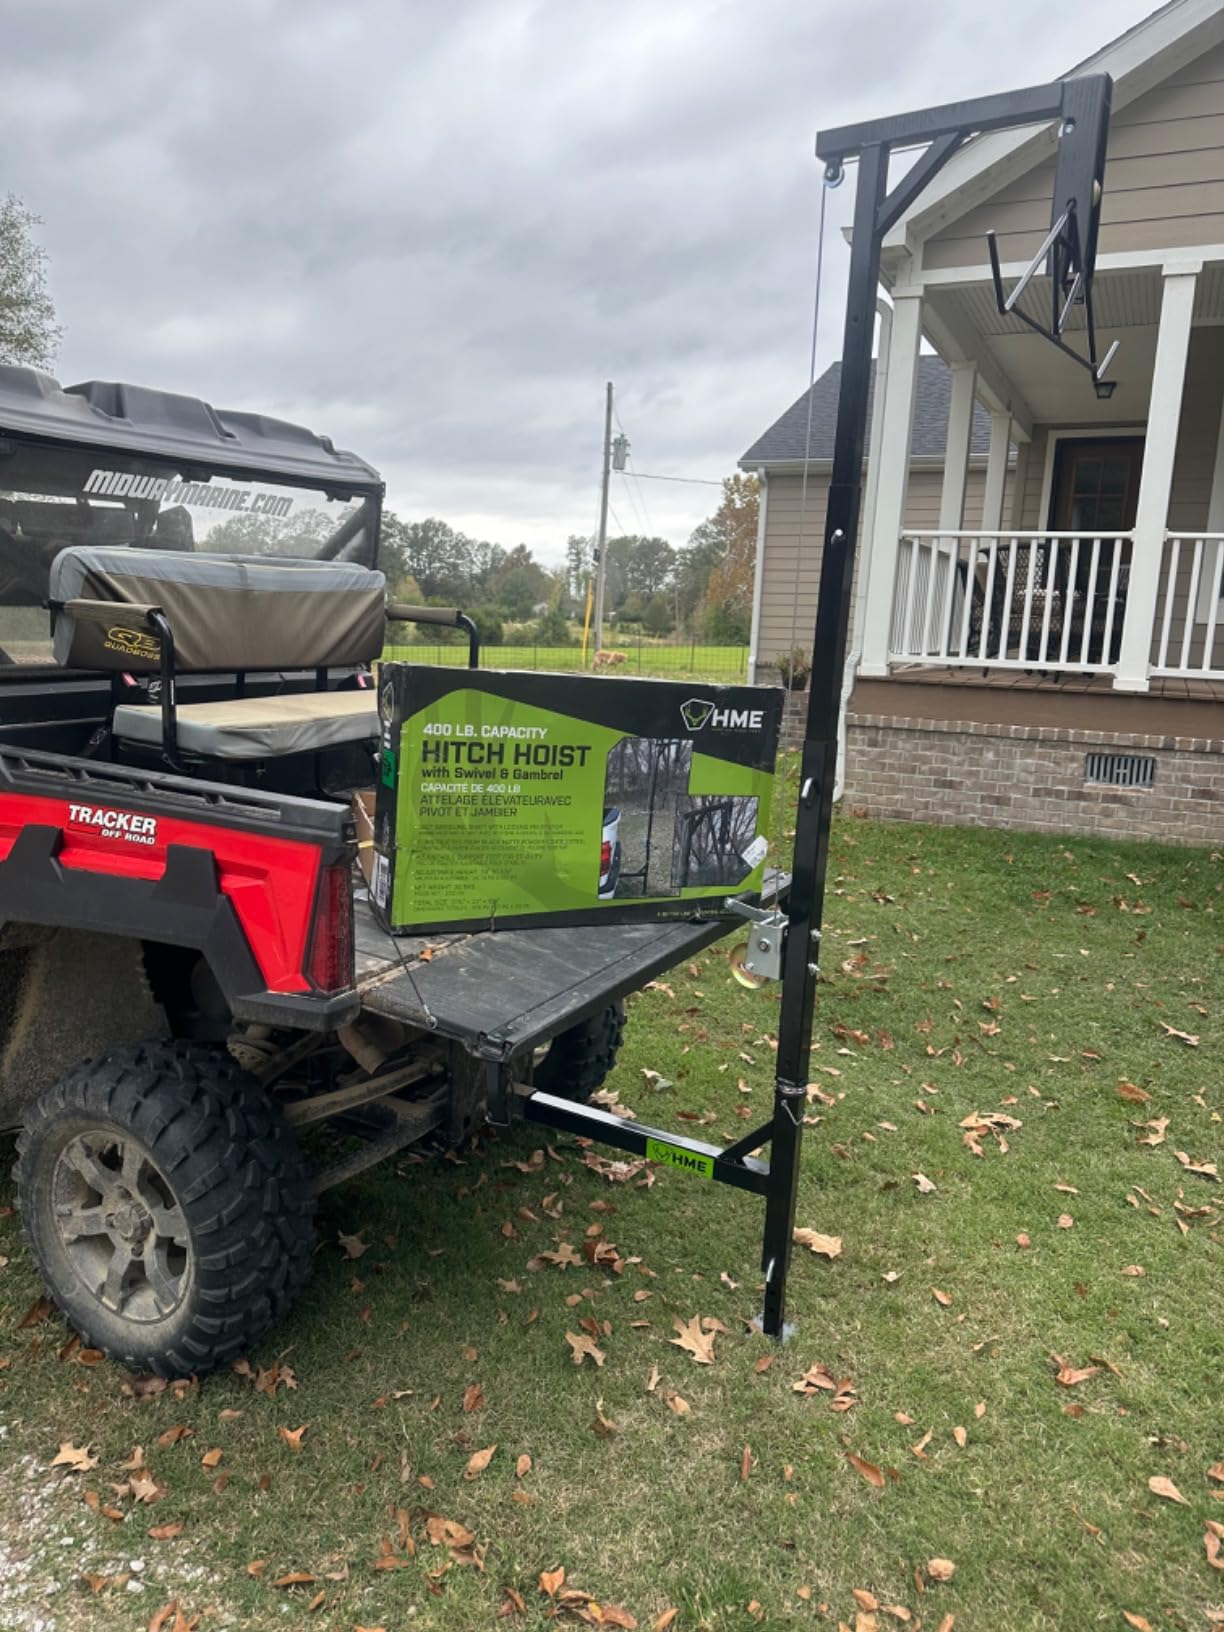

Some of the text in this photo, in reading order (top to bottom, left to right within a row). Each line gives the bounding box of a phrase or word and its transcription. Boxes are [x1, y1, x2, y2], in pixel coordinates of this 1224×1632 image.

[83, 469, 294, 517] MIDWAYMARINE.COM
[711, 709, 764, 729] HME
[423, 723, 548, 739] 400 LB. CAPACITY
[422, 740, 592, 767] HITCH HOIST
[422, 767, 563, 780] with Swivel & Gambrel
[471, 783, 485, 793] DE
[487, 783, 506, 793] 400
[508, 783, 521, 793] LB
[420, 794, 479, 805] ATTELAGE
[69, 804, 157, 835] TRACKER
[419, 806, 452, 817] PIVOT
[455, 807, 469, 817] ET
[101, 829, 156, 845] OFF ROAD
[671, 1152, 707, 1173] HME
